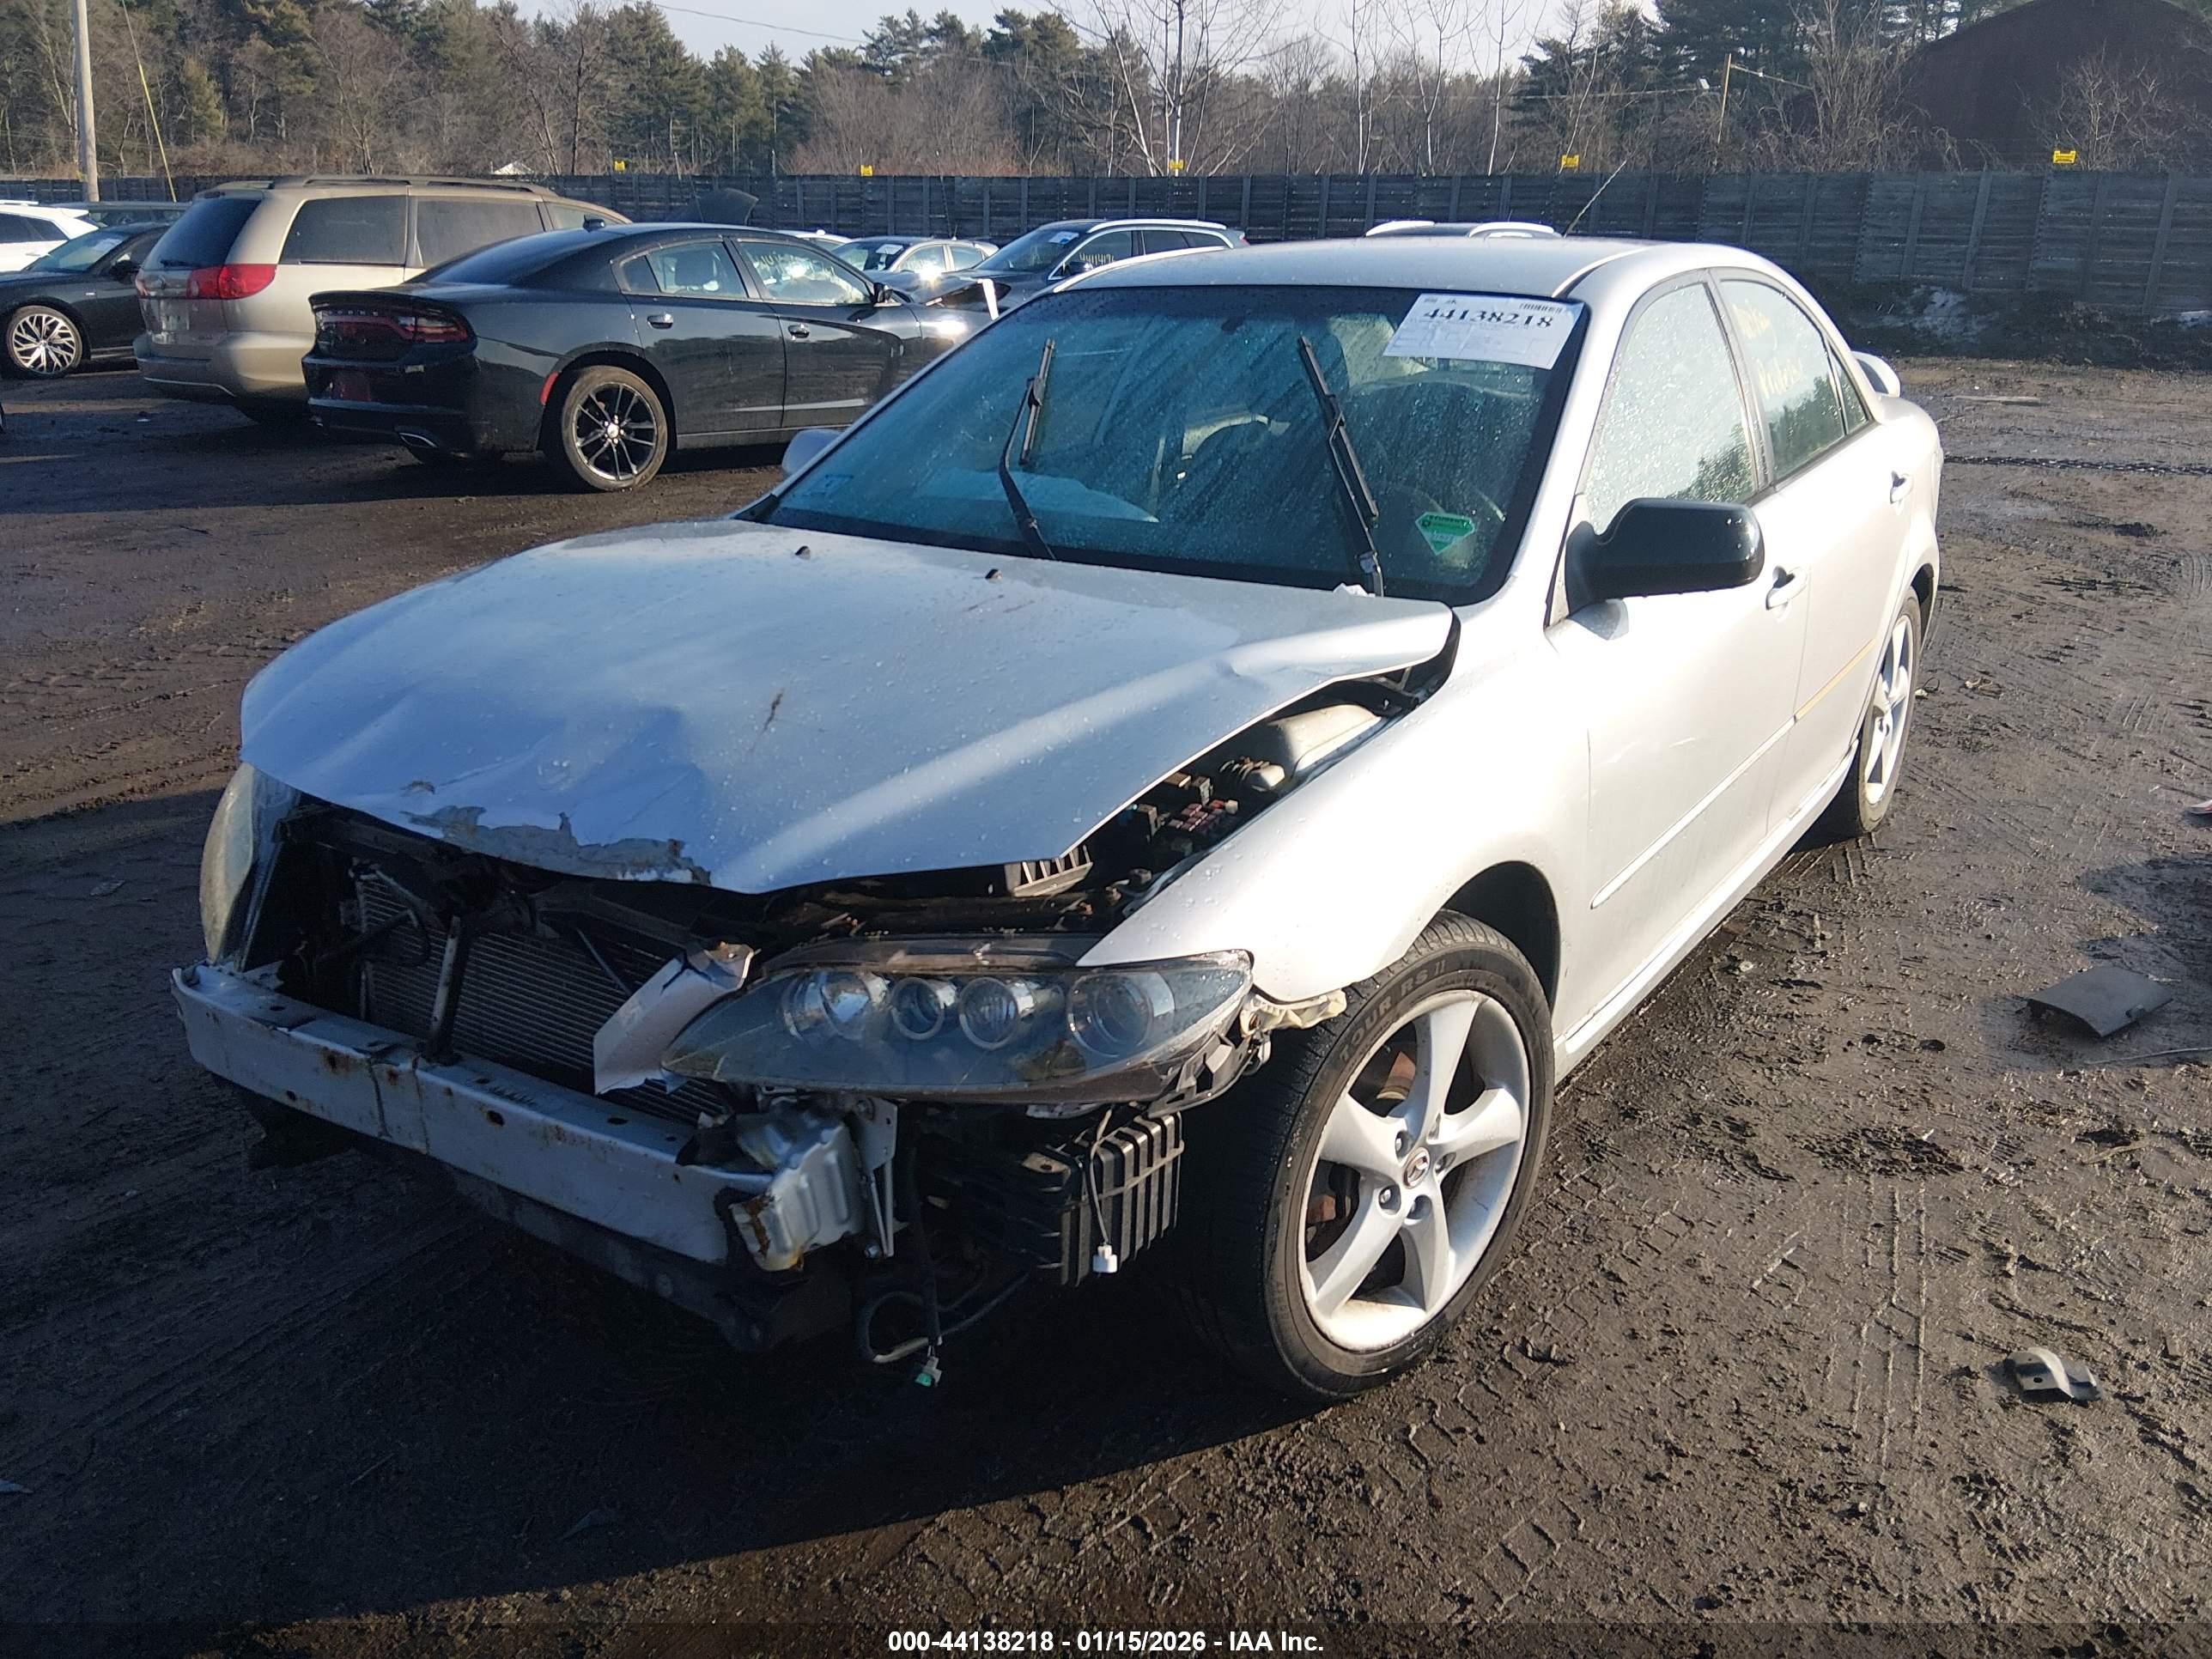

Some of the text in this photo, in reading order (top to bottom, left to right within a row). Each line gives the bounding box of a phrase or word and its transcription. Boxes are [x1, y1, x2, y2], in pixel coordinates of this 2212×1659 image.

[1423, 307, 1553, 329] 44138218
[1339, 995, 1393, 1062] TOUR
[1400, 969, 1430, 997] RS
